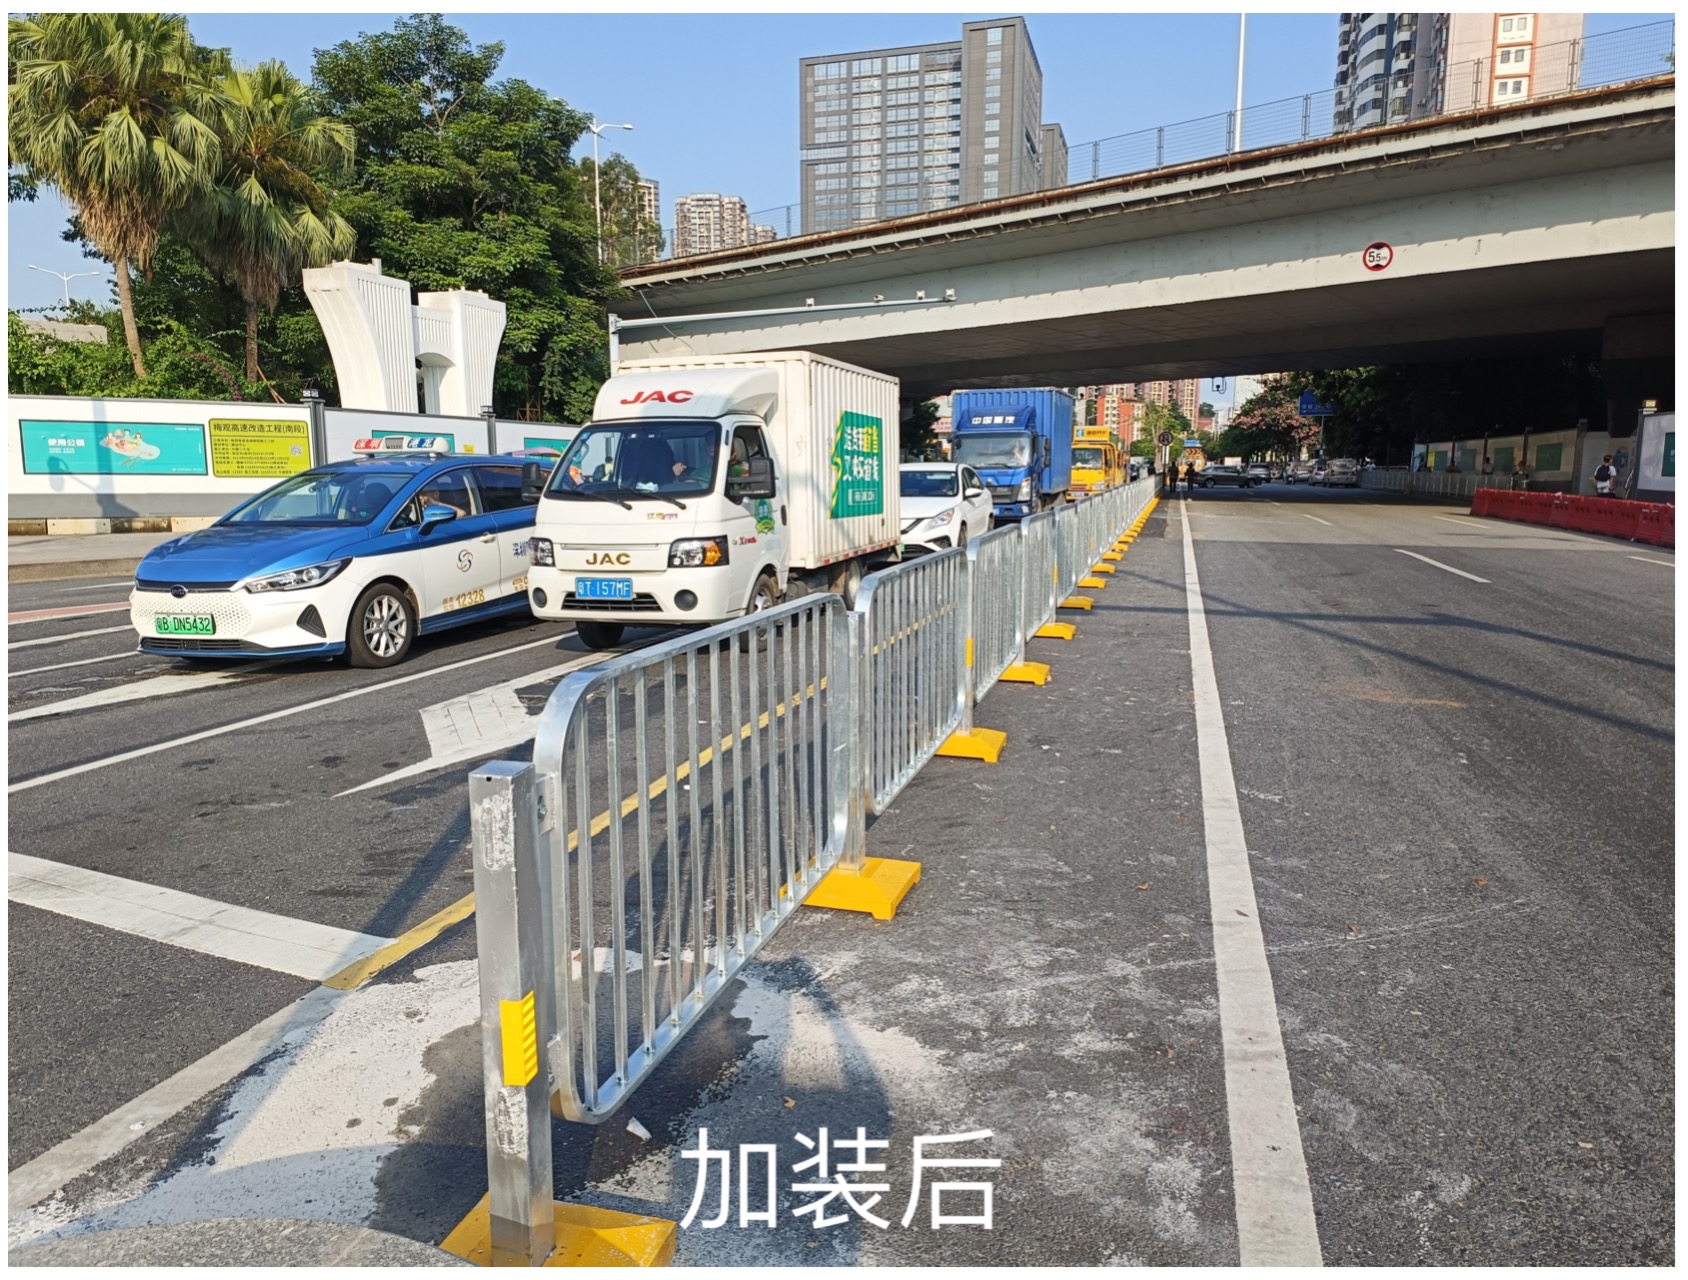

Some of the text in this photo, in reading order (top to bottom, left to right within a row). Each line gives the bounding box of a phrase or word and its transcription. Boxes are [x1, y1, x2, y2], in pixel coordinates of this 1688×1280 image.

[620, 390, 694, 405] JAC
[213, 423, 305, 434] 梅观高速改造工程(南段)
[586, 553, 631, 565] JAC
[455, 588, 486, 608] 12328
